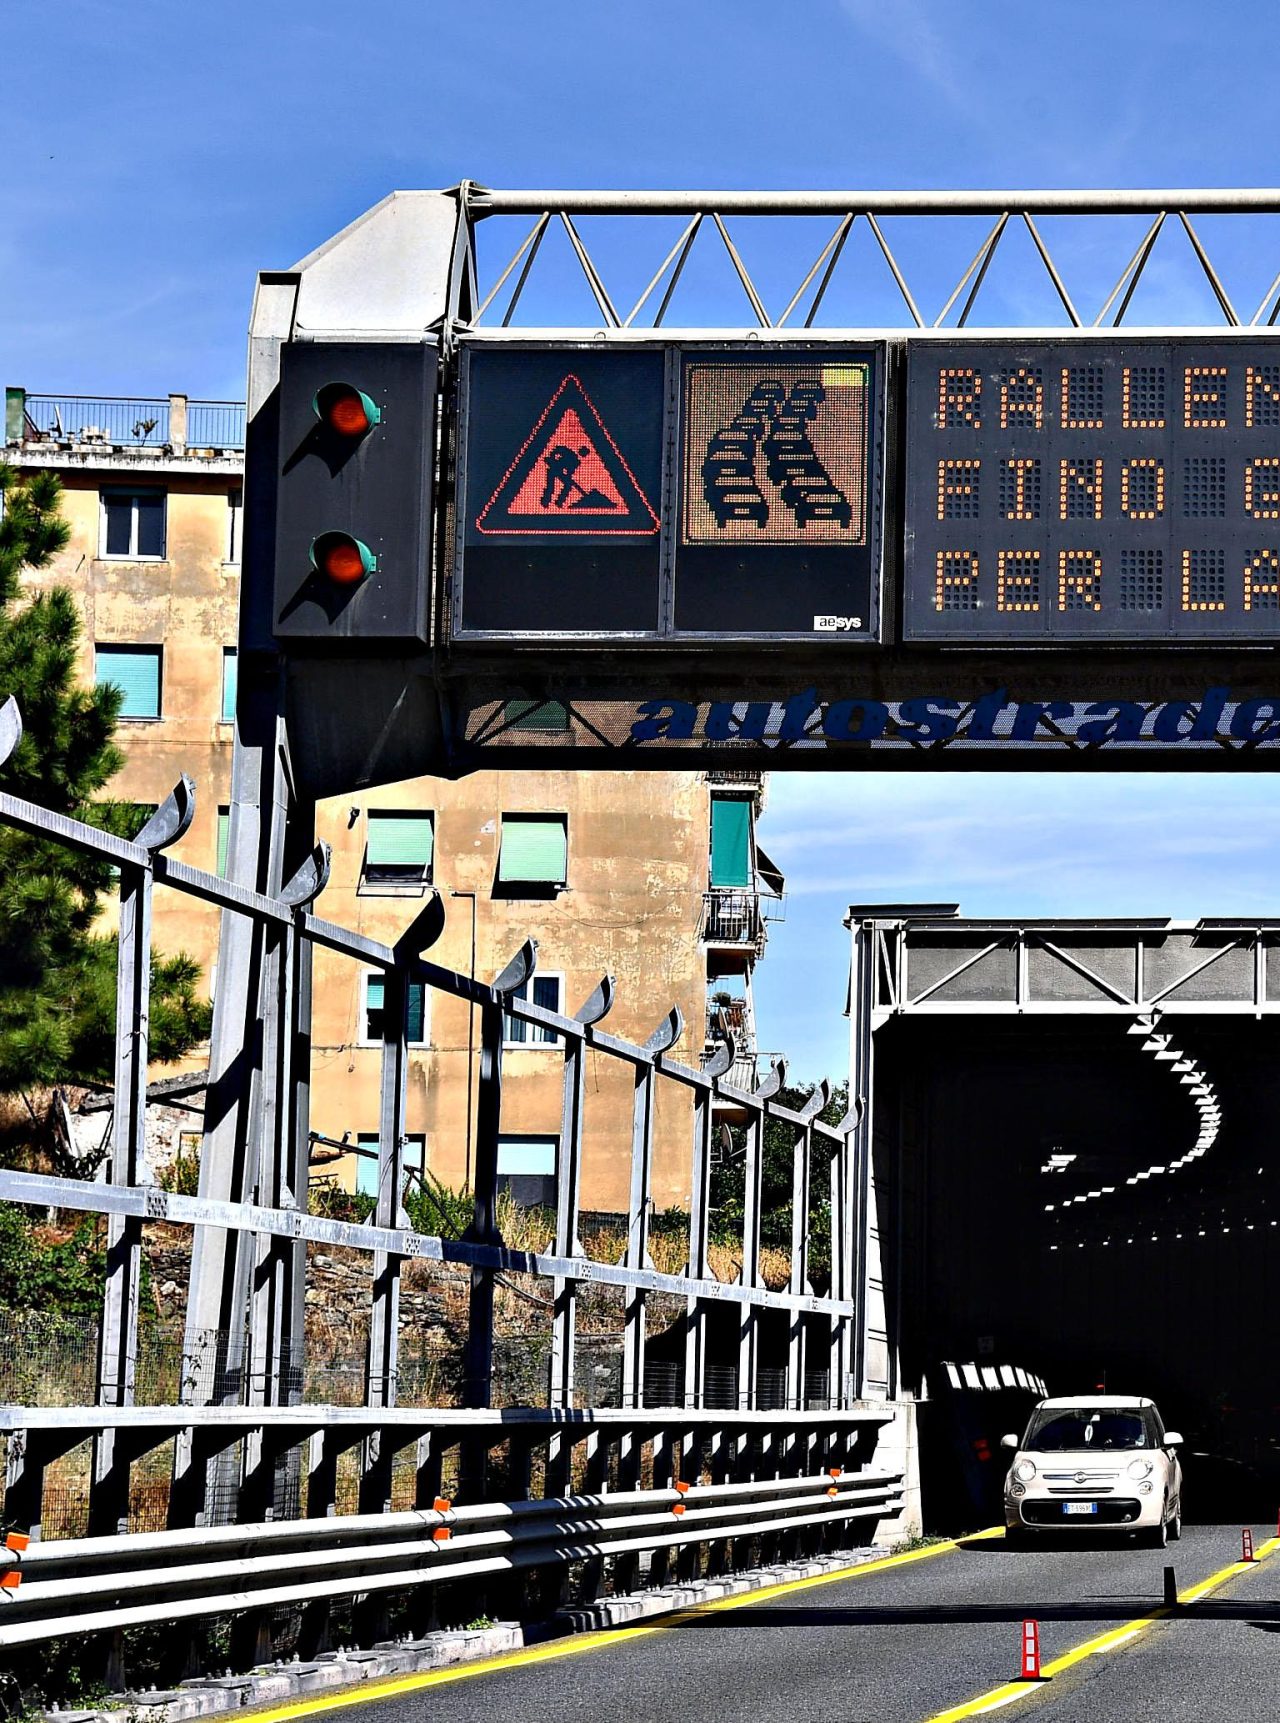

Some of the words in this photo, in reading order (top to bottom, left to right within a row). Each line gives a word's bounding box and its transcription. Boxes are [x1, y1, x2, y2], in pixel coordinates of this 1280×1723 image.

[937, 457, 1165, 520] FINO
[936, 549, 1102, 611] PER
[816, 615, 861, 631] aesys
